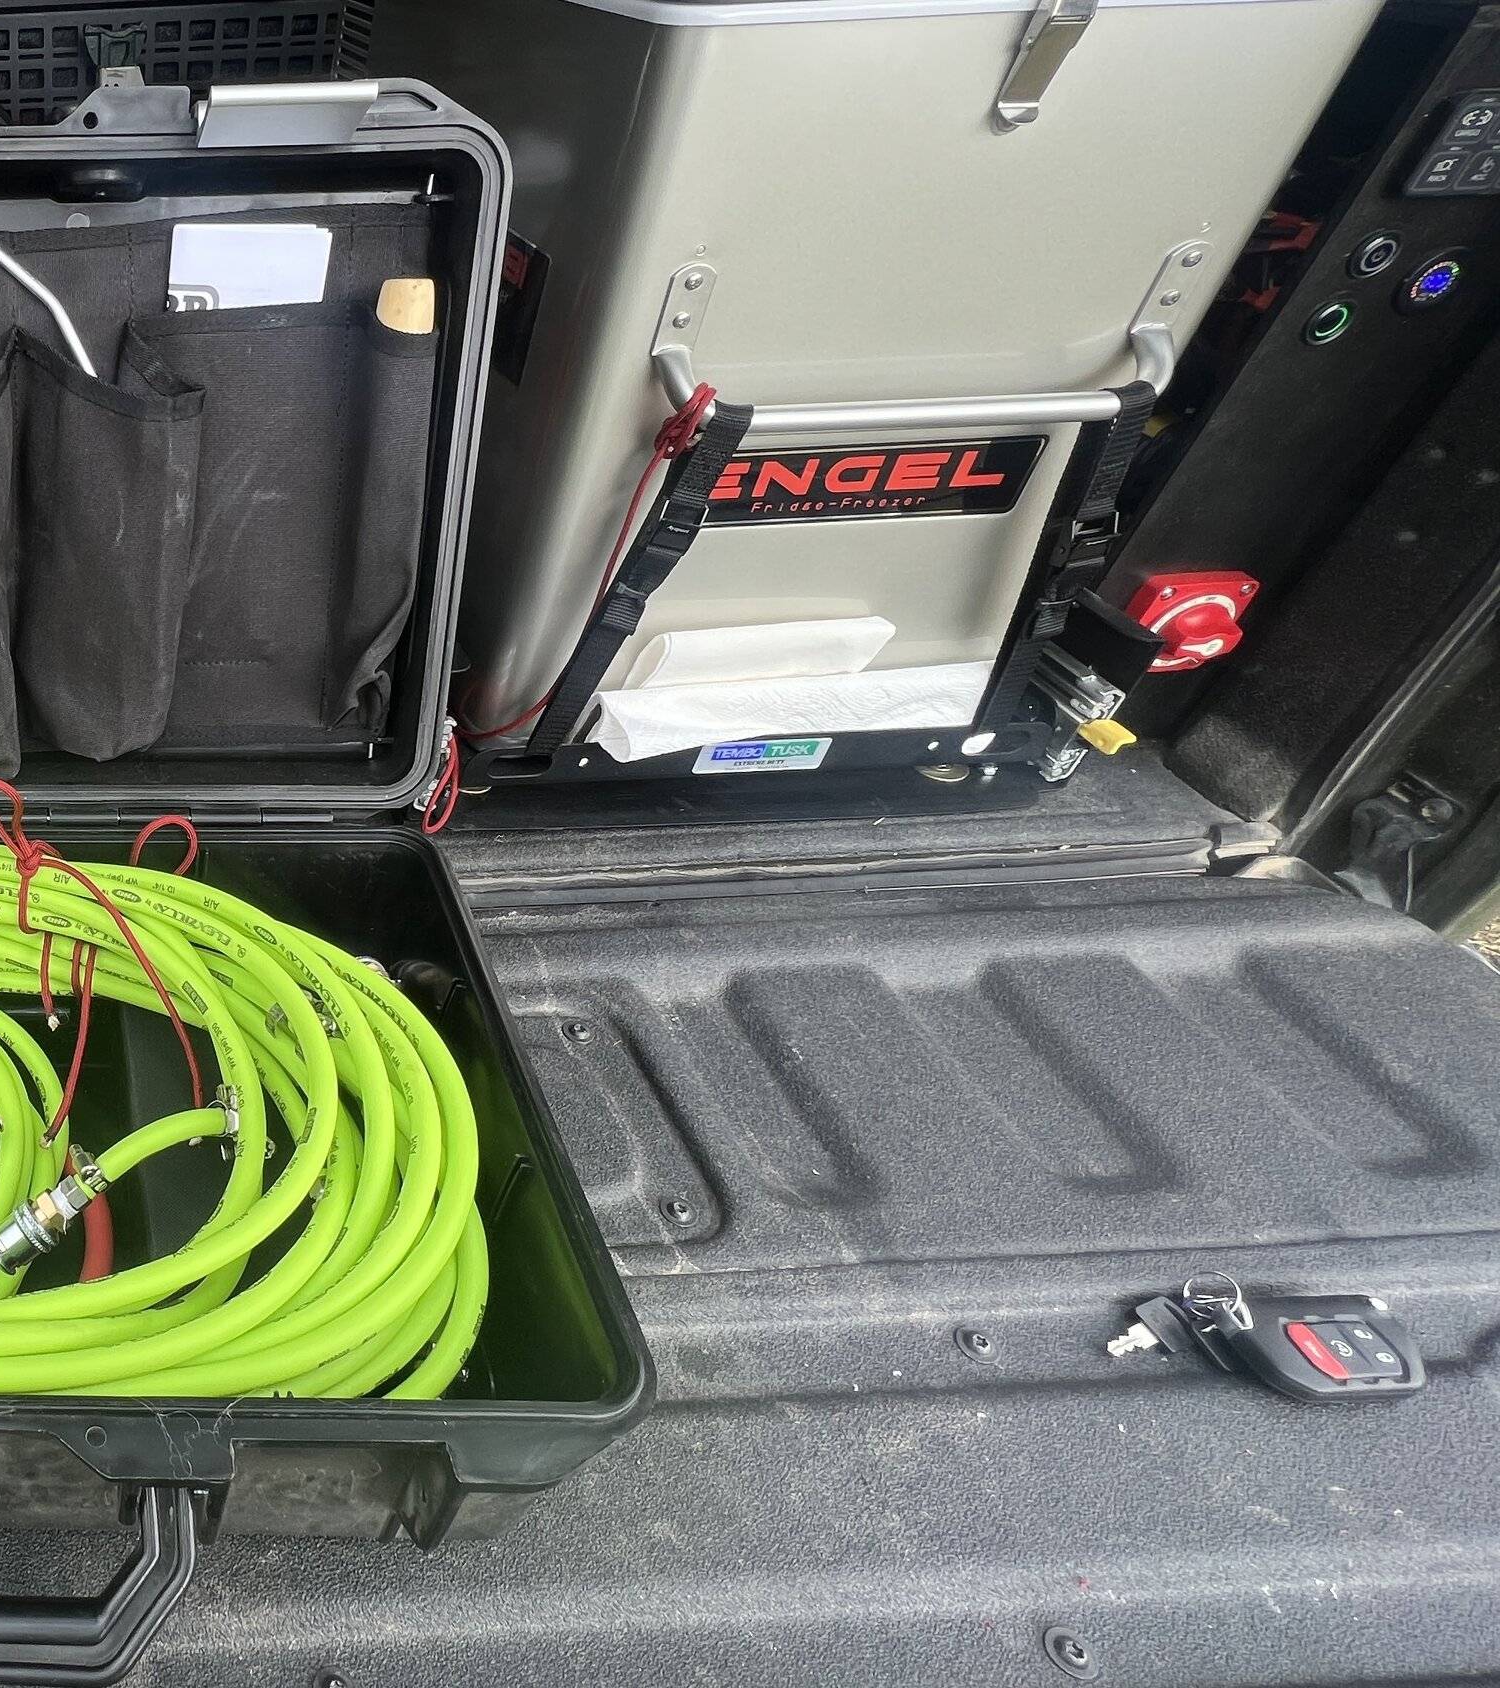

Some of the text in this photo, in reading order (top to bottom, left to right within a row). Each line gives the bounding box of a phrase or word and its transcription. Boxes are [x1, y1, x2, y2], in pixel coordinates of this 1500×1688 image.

[708, 450, 1005, 500] ENGEL
[750, 496, 926, 513] Fridge-Freezer
[714, 744, 811, 760] TEMBO TUSK
[53, 872, 71, 885] AIR
[202, 896, 220, 910] AIR
[153, 903, 231, 946] FLEXZILLA
